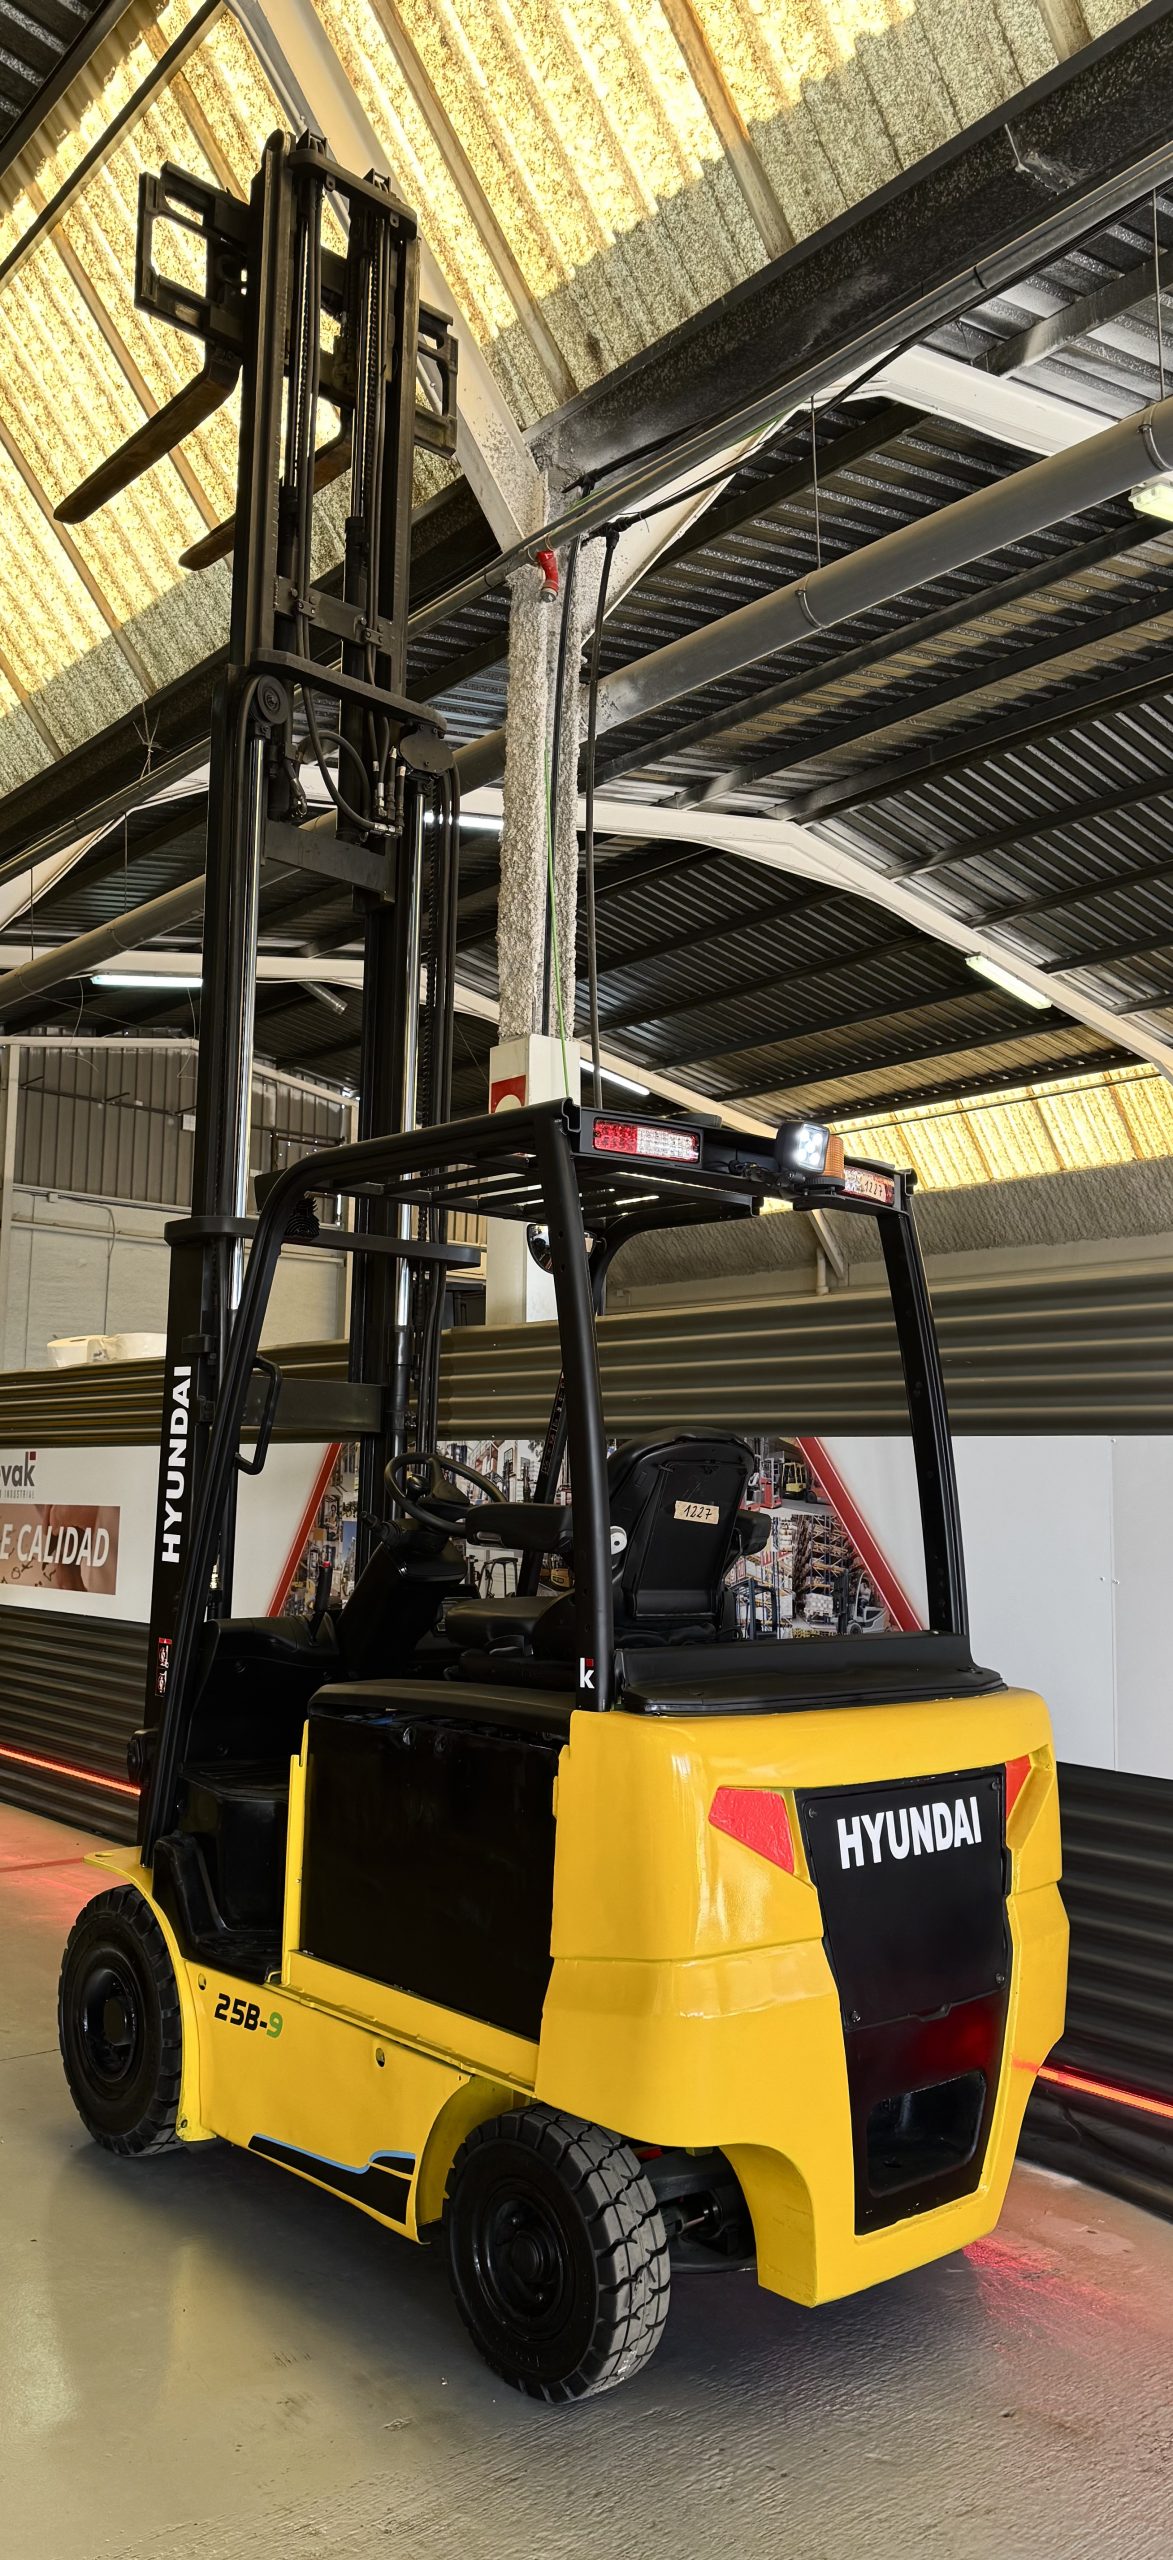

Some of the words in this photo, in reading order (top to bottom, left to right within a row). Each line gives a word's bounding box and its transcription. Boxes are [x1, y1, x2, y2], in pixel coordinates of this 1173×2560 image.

[0, 1451, 36, 1487] vak
[161, 1365, 192, 1564] HYUNDAI
[683, 1504, 713, 1520] 1227
[17, 1524, 110, 1567] CALIDAD
[836, 1796, 982, 1870] HYUNDAI
[214, 1992, 284, 2039] 25B-9
